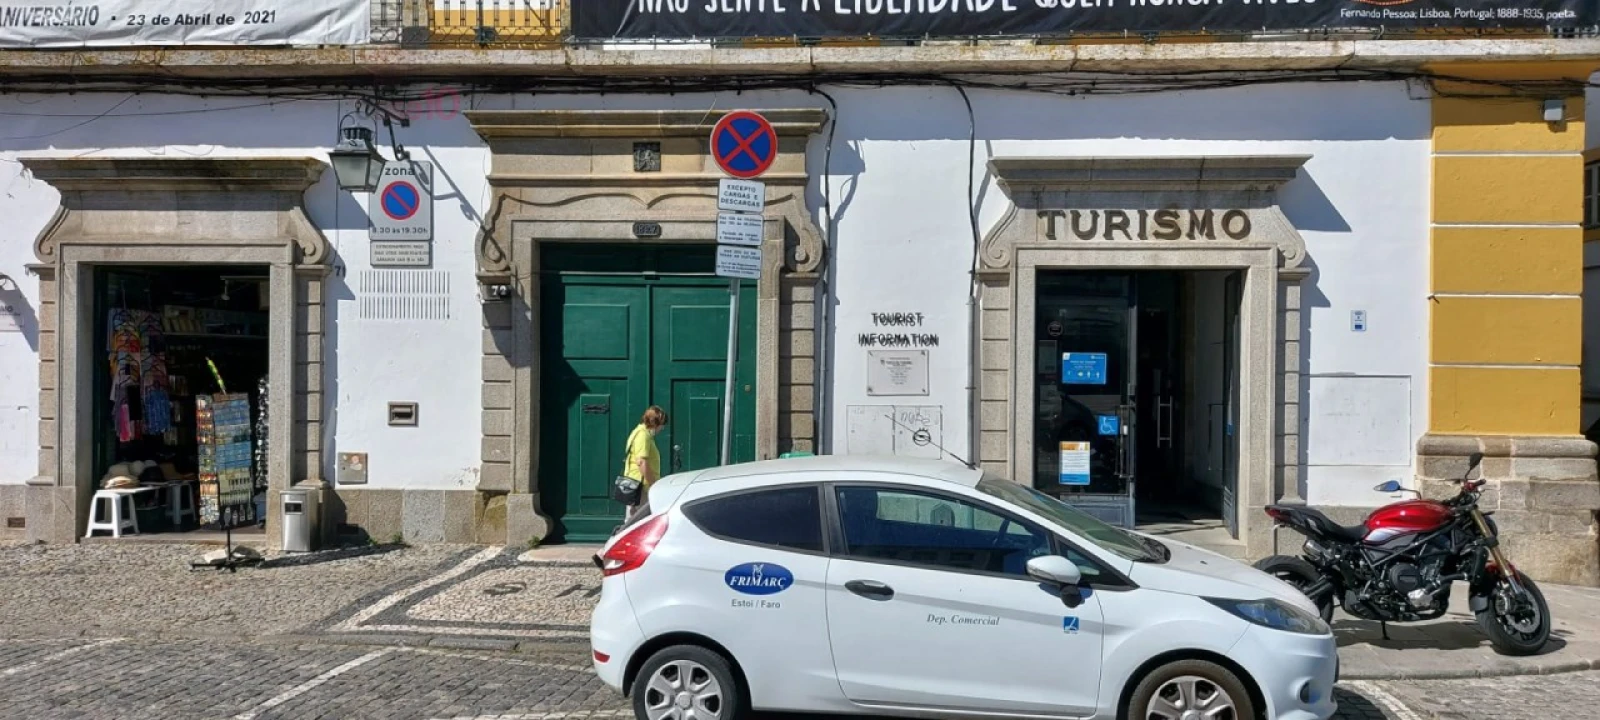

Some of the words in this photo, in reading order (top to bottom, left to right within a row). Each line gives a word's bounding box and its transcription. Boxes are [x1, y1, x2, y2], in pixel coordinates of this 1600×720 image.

[127, 15, 146, 25] 23
[152, 14, 170, 25] de
[174, 14, 210, 25] Abril
[216, 14, 235, 25] de
[244, 10, 276, 24] 2021
[1340, 8, 1381, 18] Fernando
[1546, 9, 1577, 20] poeta.
[385, 167, 415, 176] zona
[724, 190, 750, 199] CARGAS
[727, 184, 756, 193] EXCEPTO
[720, 197, 760, 207] DESCARGAS
[1036, 208, 1252, 241] TURISMO
[871, 312, 924, 326] TOURIST
[858, 333, 940, 347] INFORMATION
[760, 600, 781, 609] Faro
[926, 613, 947, 624] Dep.
[950, 614, 1000, 626] Comercial
